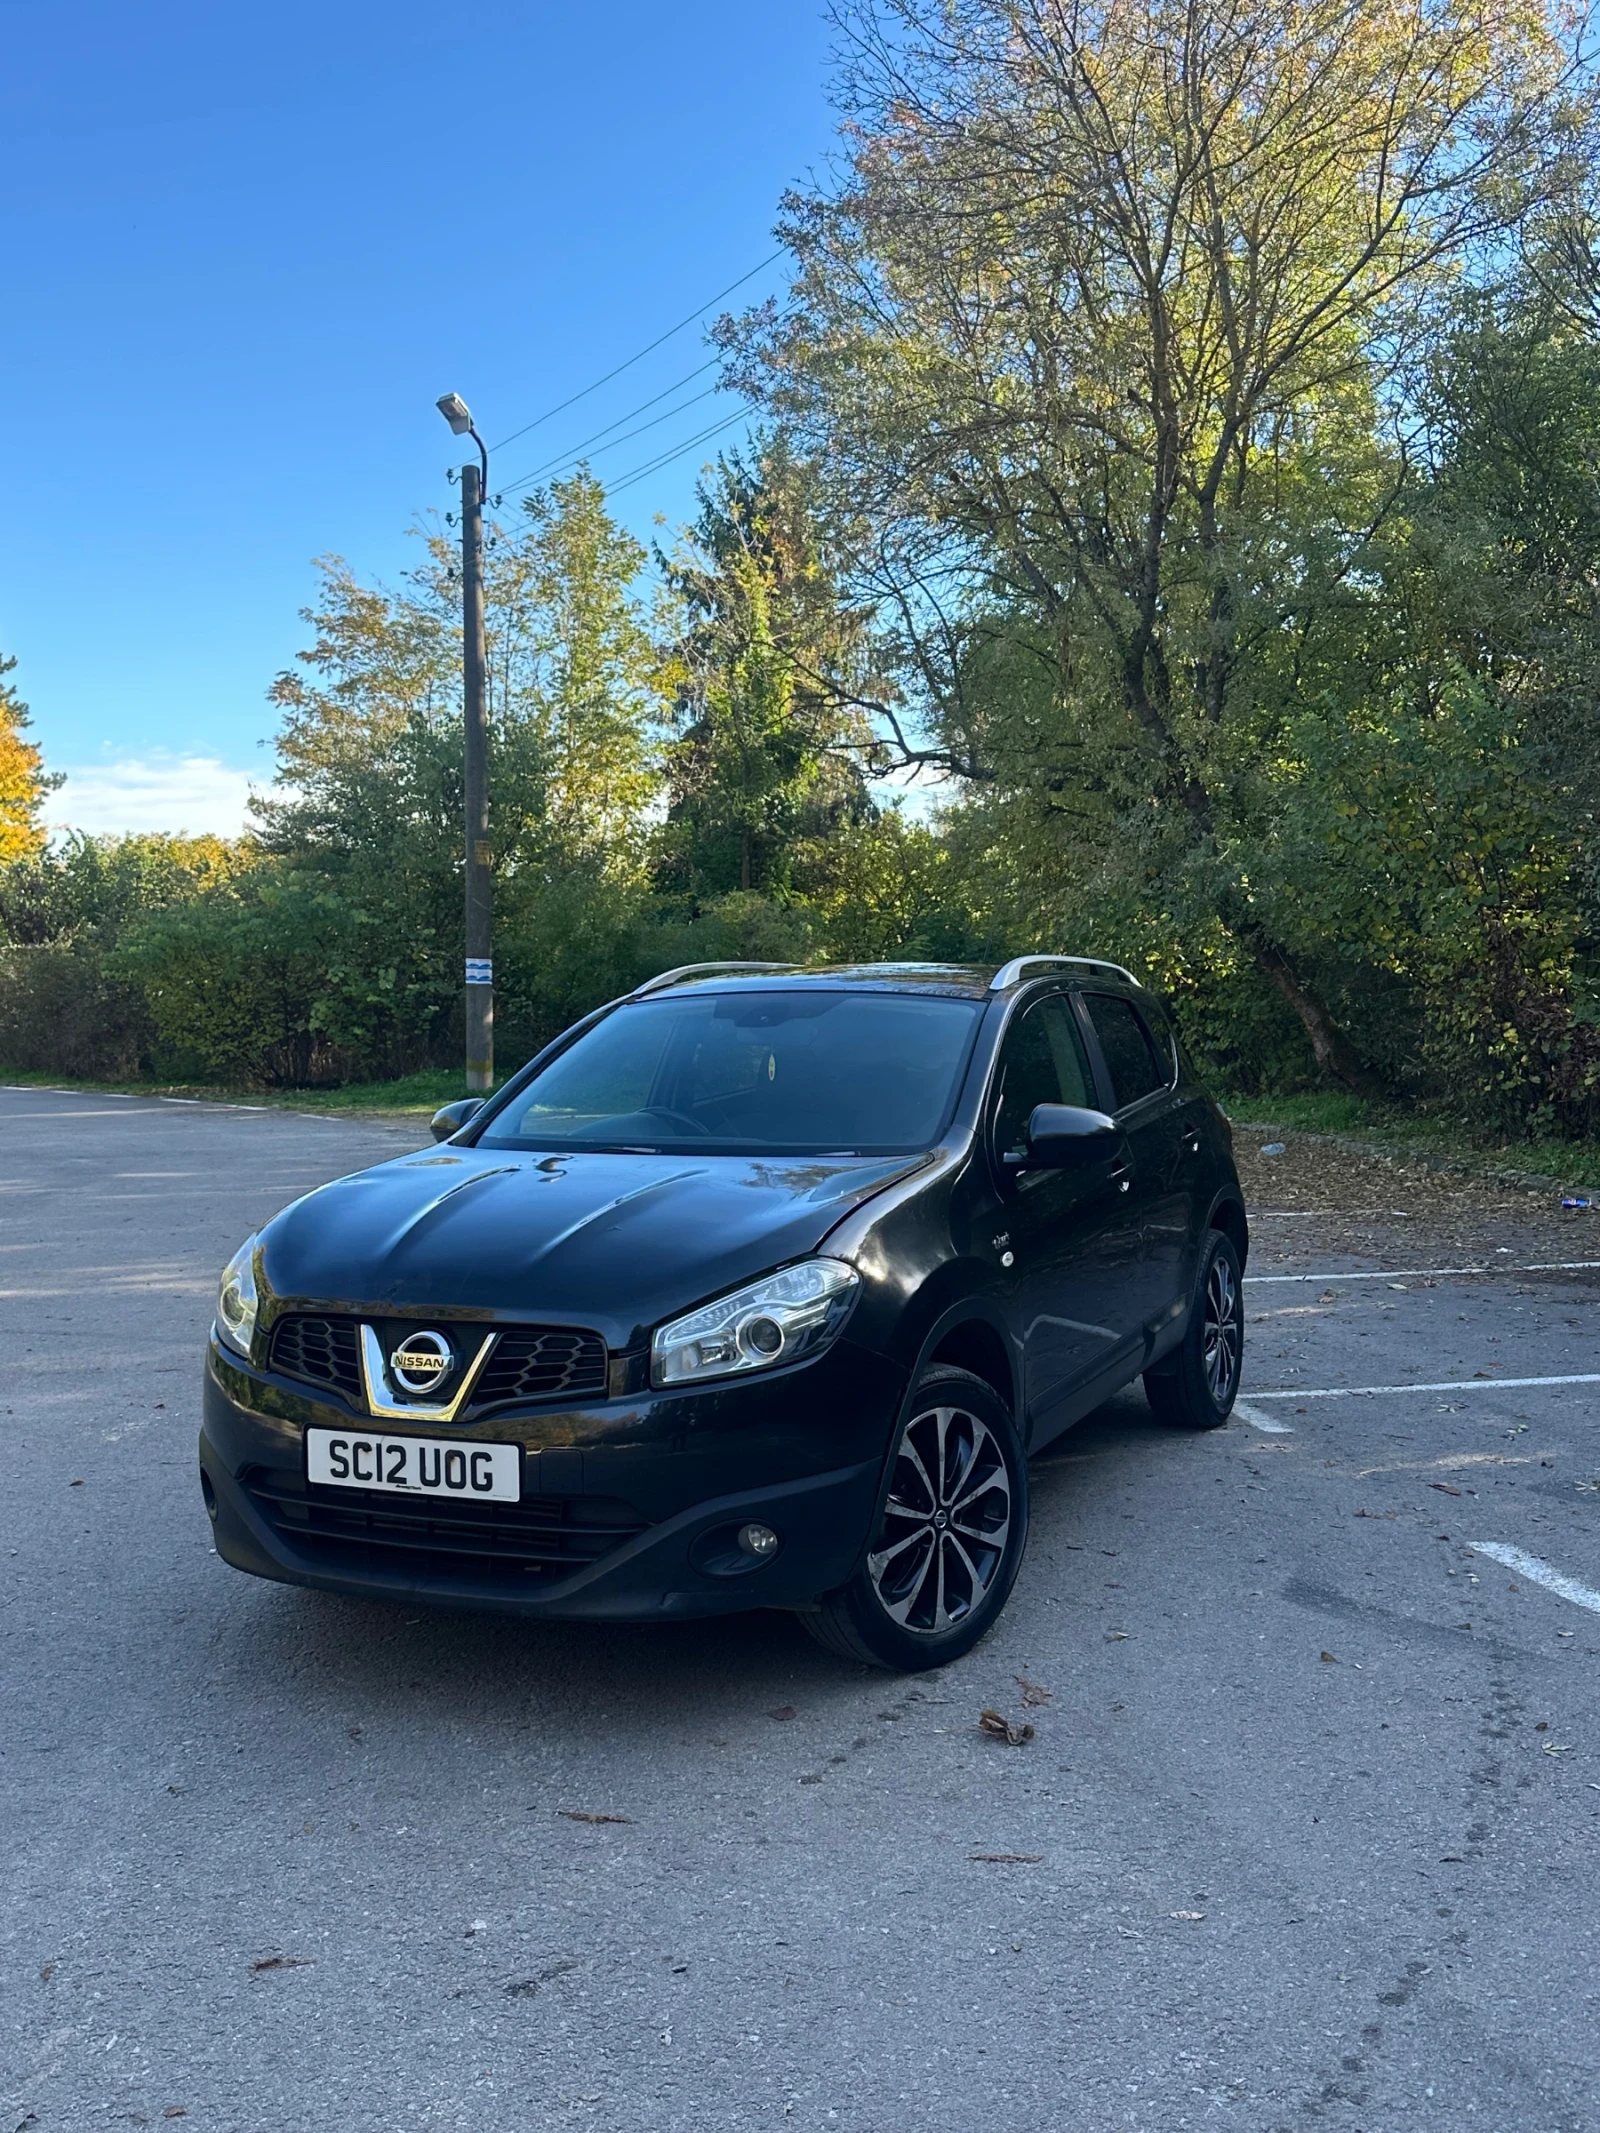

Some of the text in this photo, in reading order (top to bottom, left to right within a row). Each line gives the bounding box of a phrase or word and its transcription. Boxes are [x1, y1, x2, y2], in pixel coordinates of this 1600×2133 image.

[395, 1355, 444, 1368] NISSAN
[329, 1439, 493, 1492] SC12 UOG
